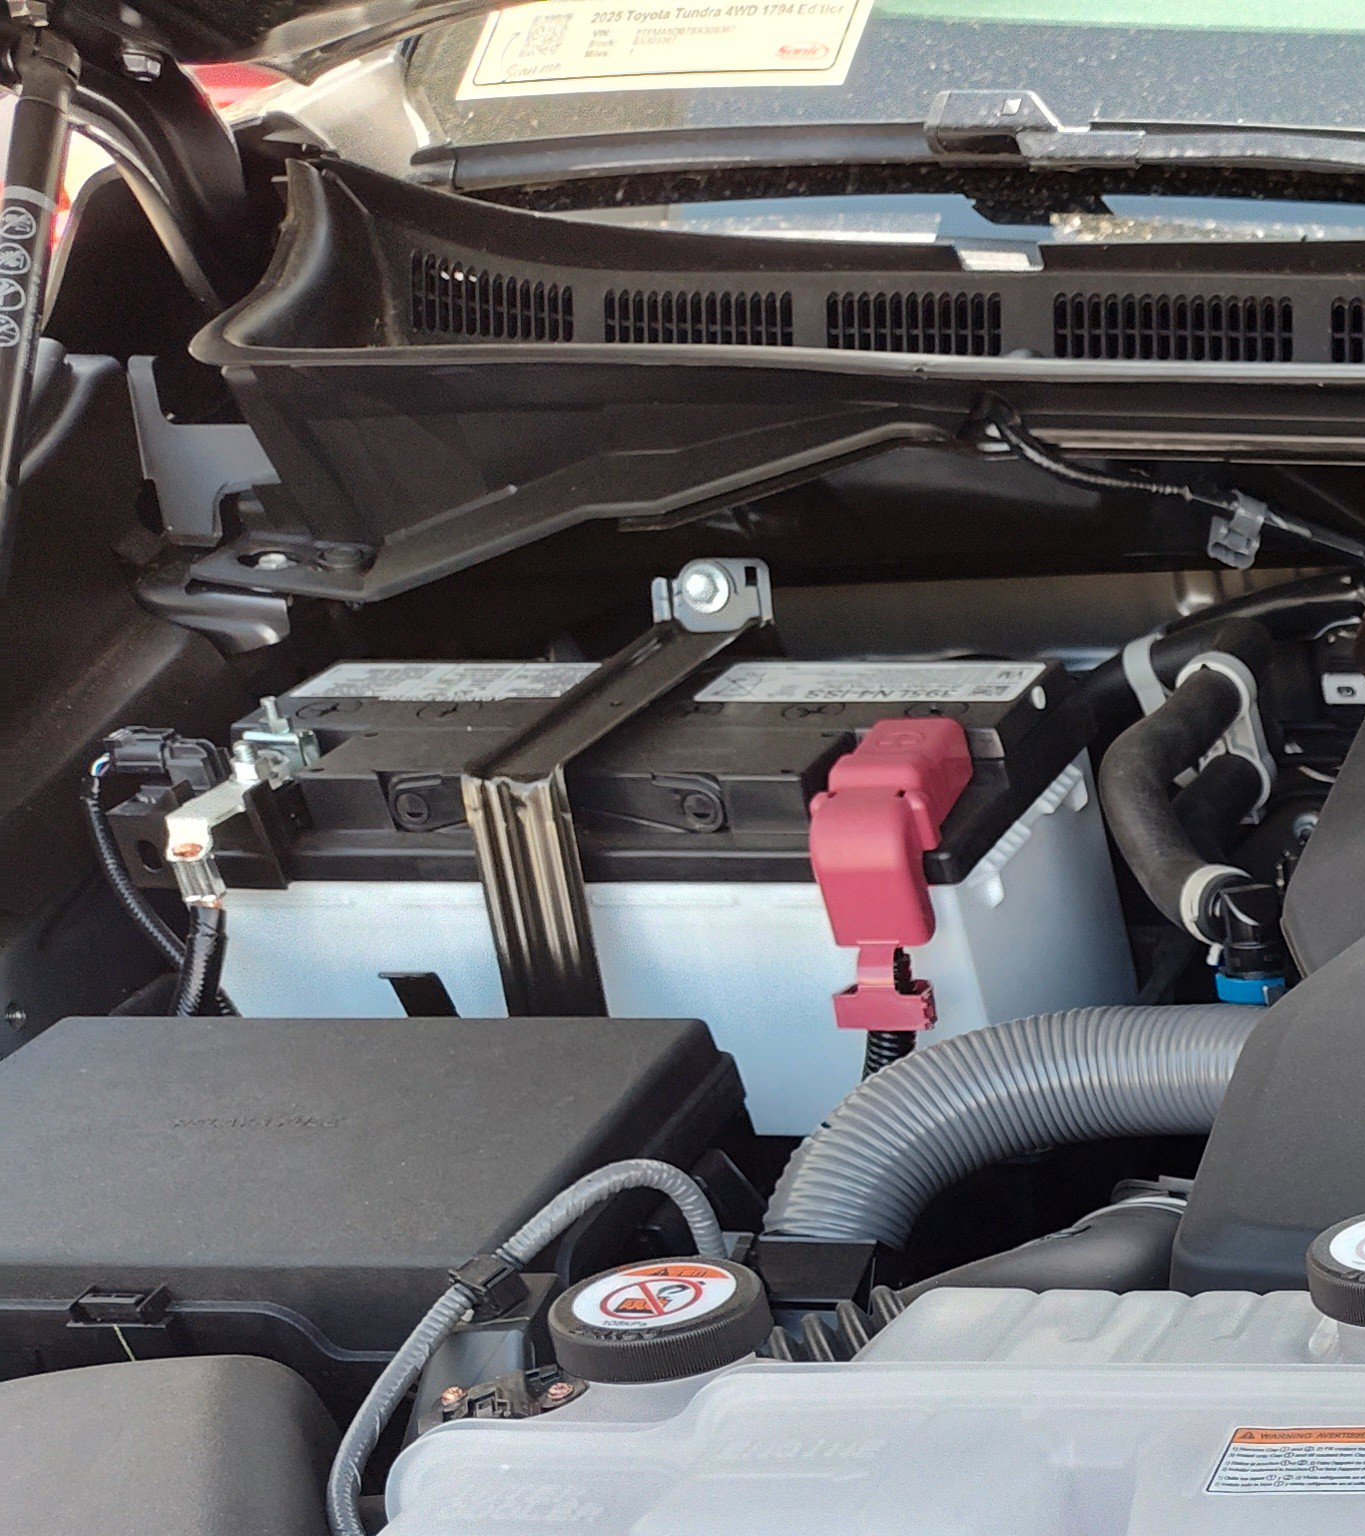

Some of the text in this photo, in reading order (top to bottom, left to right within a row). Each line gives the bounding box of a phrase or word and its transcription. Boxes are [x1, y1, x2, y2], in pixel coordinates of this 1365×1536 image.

[591, 11, 623, 23] 2025
[627, 9, 670, 23] Toyota
[675, 6, 721, 19] Tundra
[724, 4, 757, 16] 4WD
[763, 3, 794, 15] 1794
